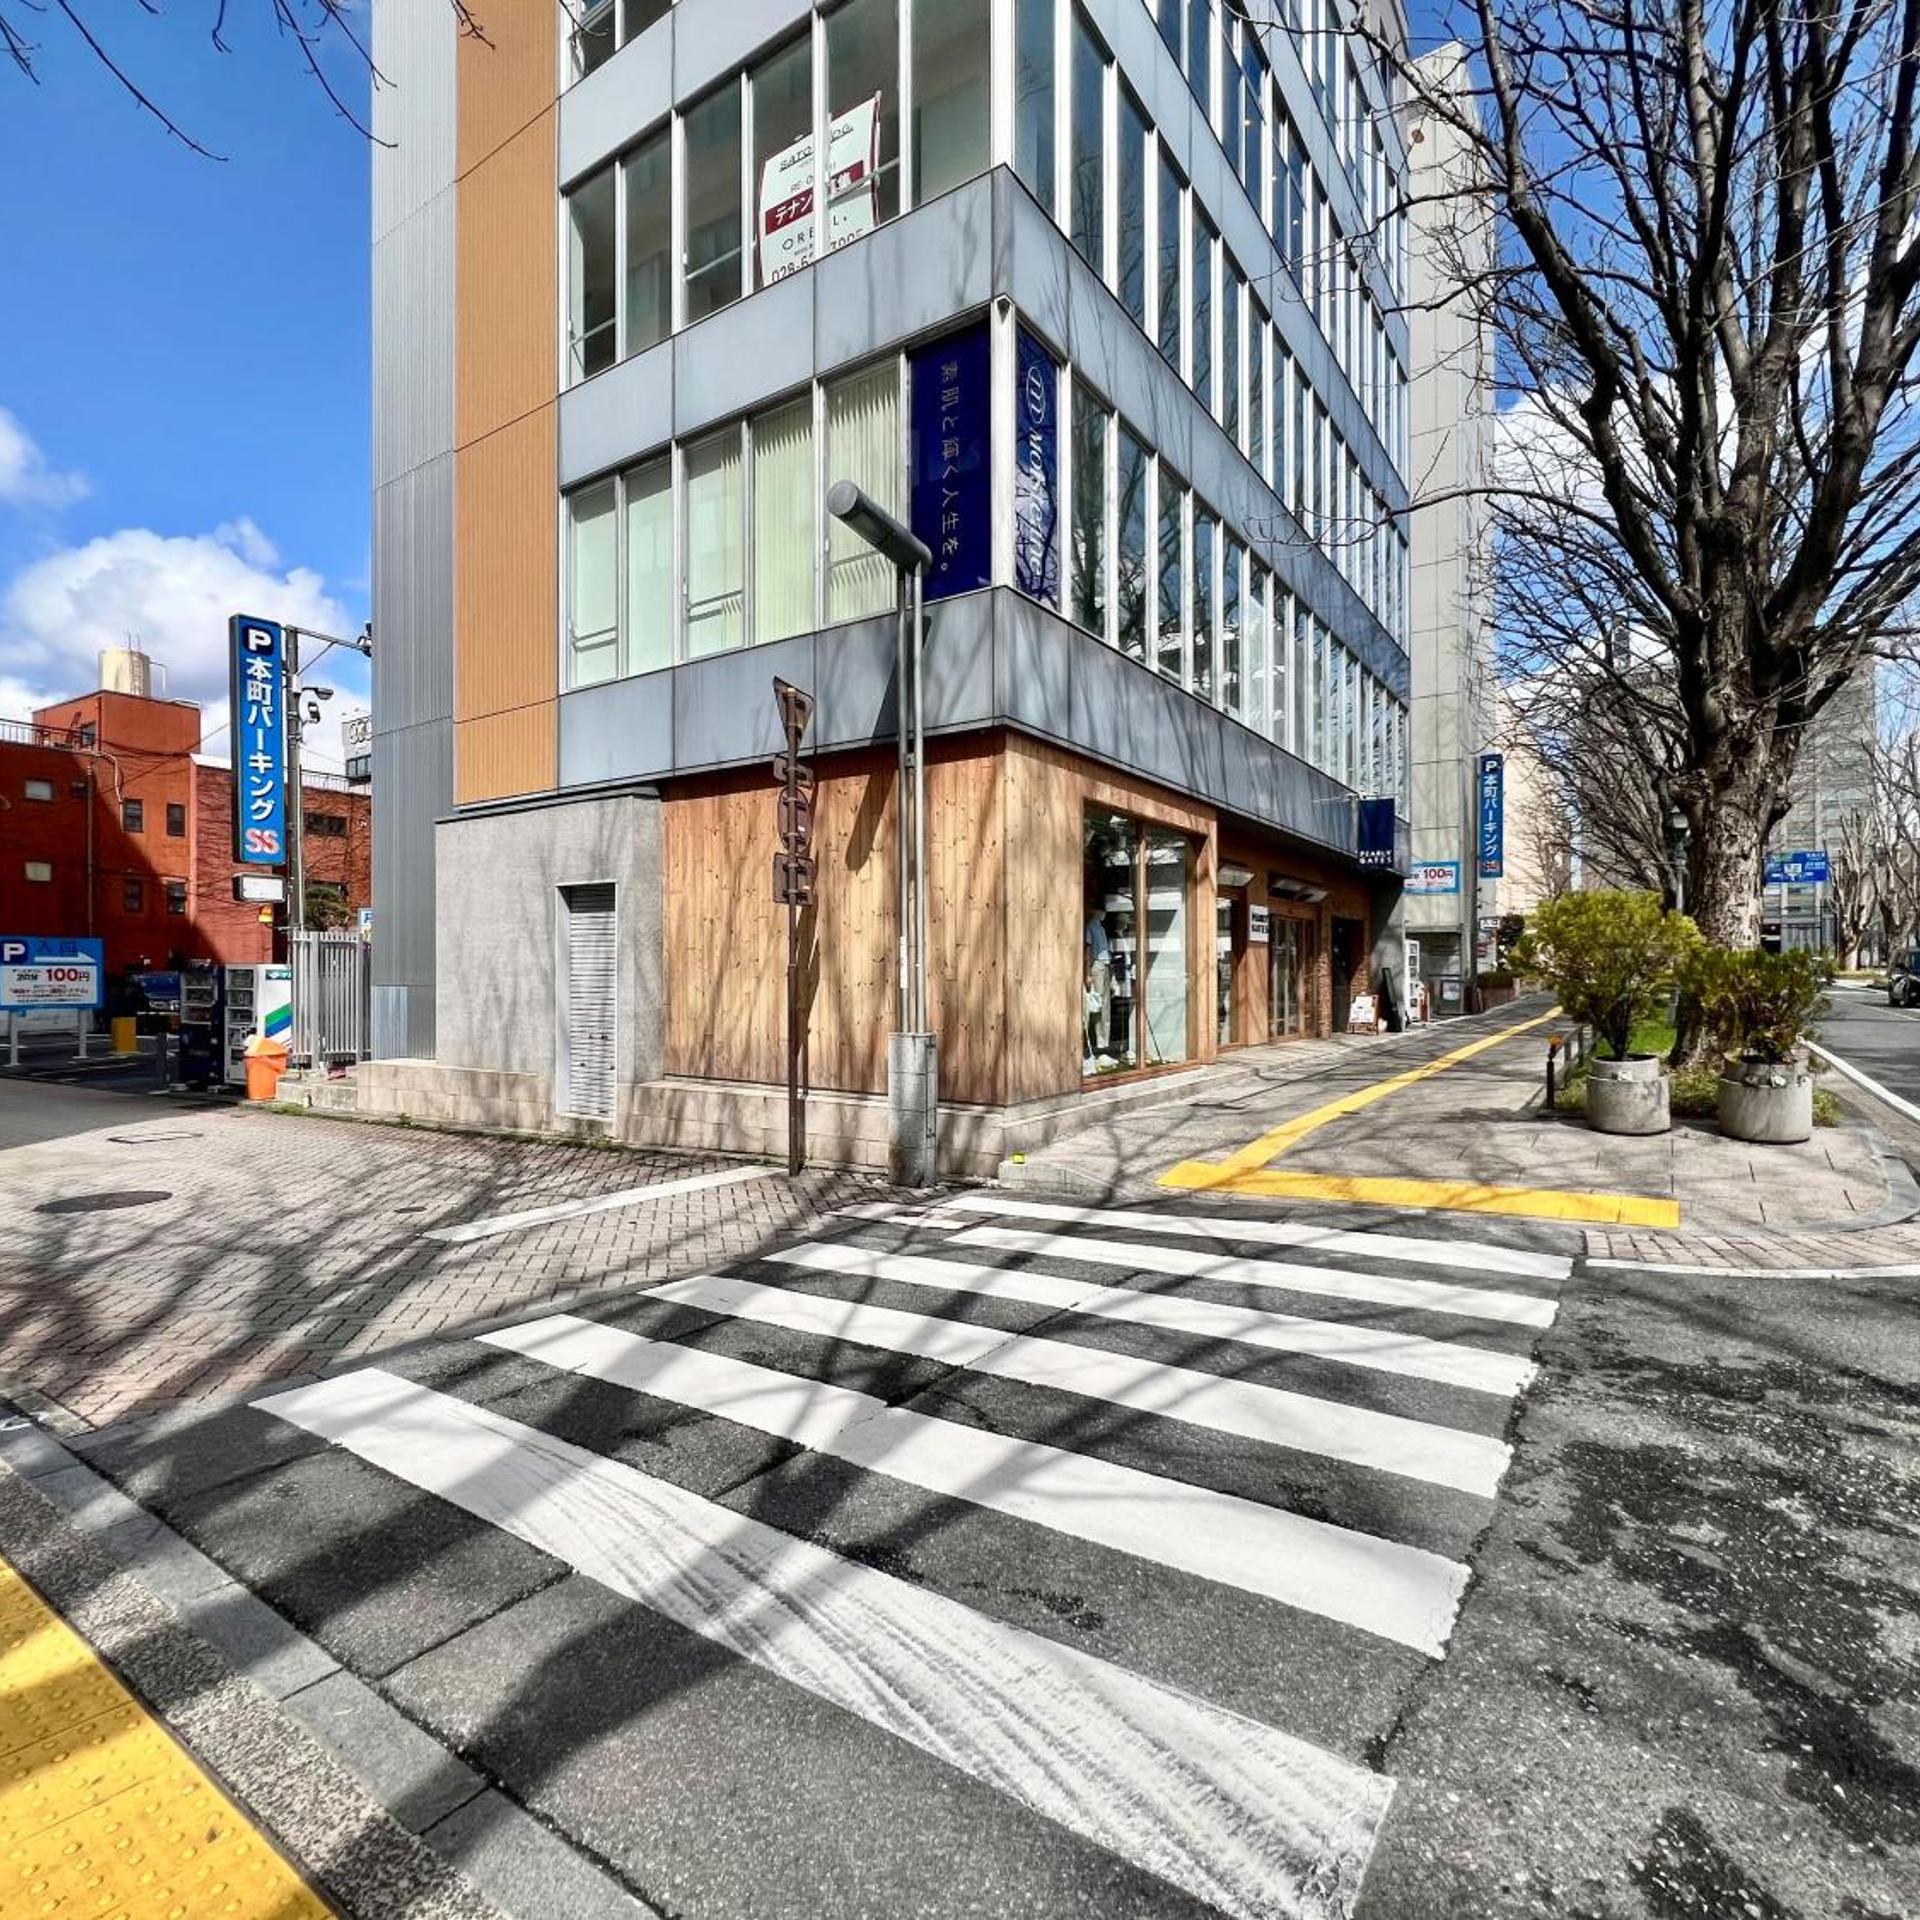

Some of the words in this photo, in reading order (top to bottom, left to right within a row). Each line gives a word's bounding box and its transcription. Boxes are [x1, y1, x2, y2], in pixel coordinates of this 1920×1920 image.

[248, 628, 272, 652] P
[246, 656, 275, 821] 本町パーキング
[1486, 761, 1498, 772] P
[1484, 774, 1499, 857] 本町パーキング
[3, 943, 26, 962] P
[46, 968, 91, 982] 100円
